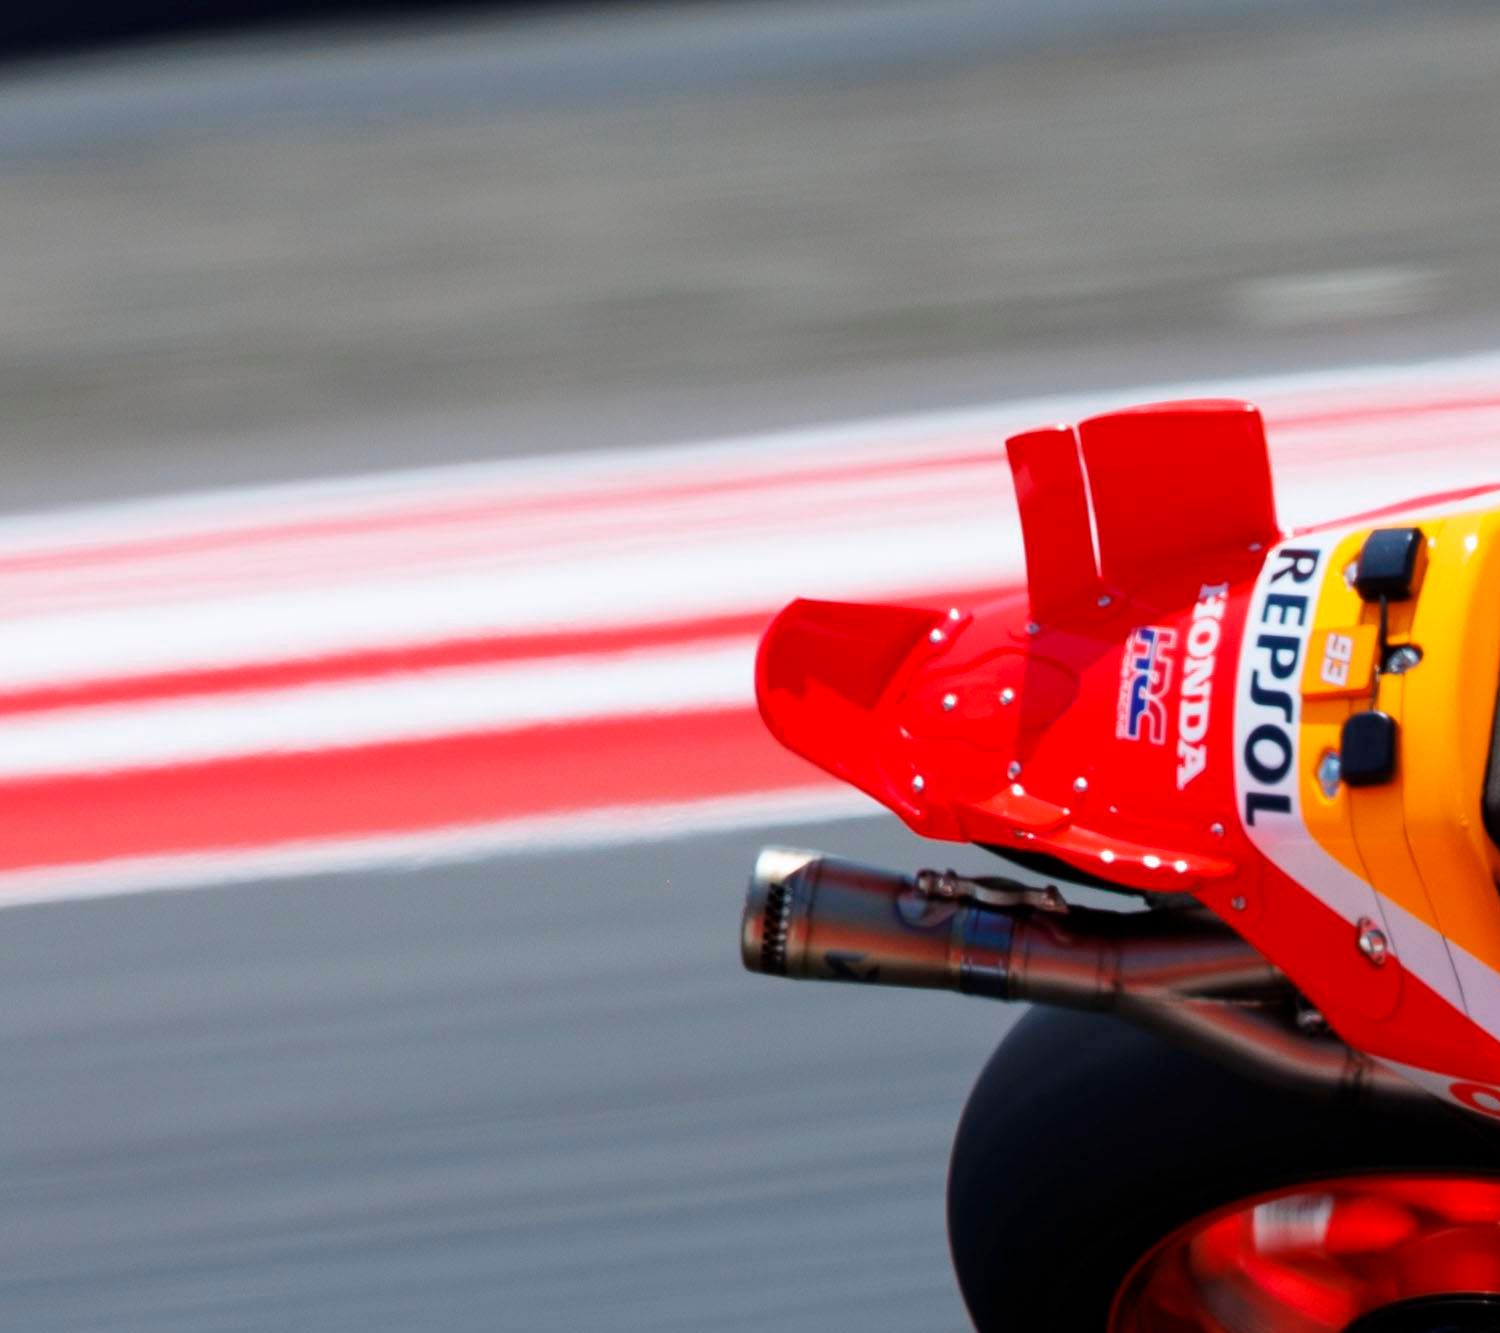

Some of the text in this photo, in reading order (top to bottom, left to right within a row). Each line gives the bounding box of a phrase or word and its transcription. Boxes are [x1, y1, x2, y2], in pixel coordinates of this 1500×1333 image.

[1128, 625, 1176, 745] HRC
[1177, 582, 1228, 790] HONDA
[1243, 549, 1320, 826] REPSOL
[1321, 632, 1354, 687] 93
